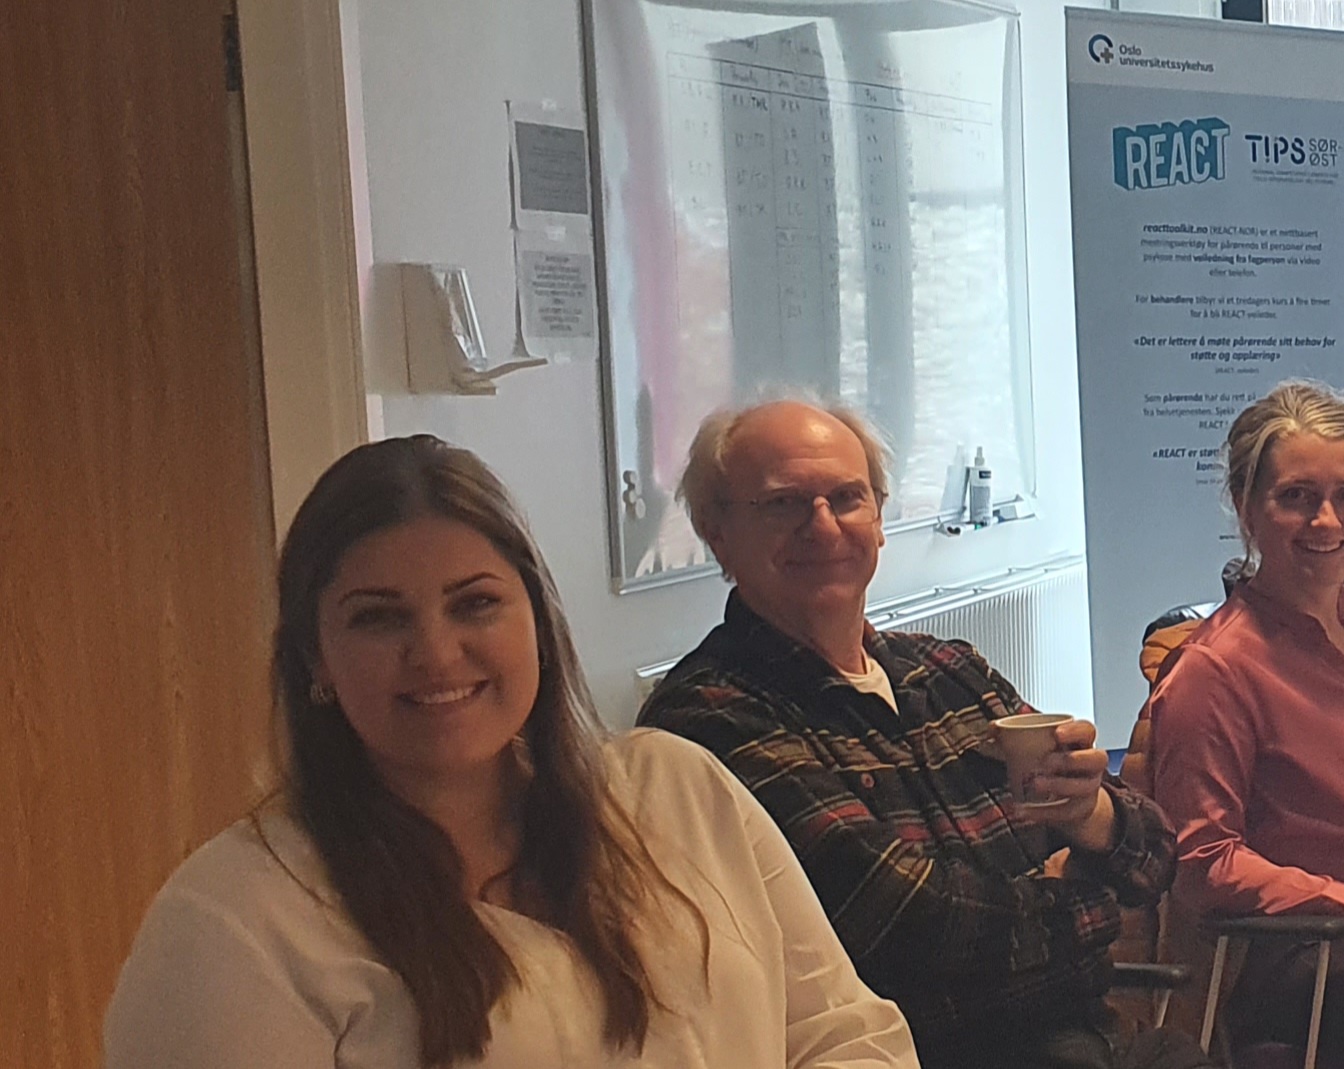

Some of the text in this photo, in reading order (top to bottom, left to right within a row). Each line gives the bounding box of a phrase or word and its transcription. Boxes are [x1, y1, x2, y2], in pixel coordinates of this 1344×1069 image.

[1119, 44, 1142, 56] Oslo
[1119, 57, 1214, 72] universitetssykehus
[1113, 117, 1230, 190] REACT
[1309, 153, 1338, 167] ØST
[1143, 223, 1208, 234] reacttoolkit.no
[1134, 335, 1337, 348] «Det er lettere å møte pårørende sitt behov for
[1190, 350, 1281, 362] støtte og opplæring»
[1163, 392, 1203, 404] pårørende
[1220, 392, 1231, 402] du
[1198, 420, 1224, 430] REACT
[1187, 449, 1198, 458] er
